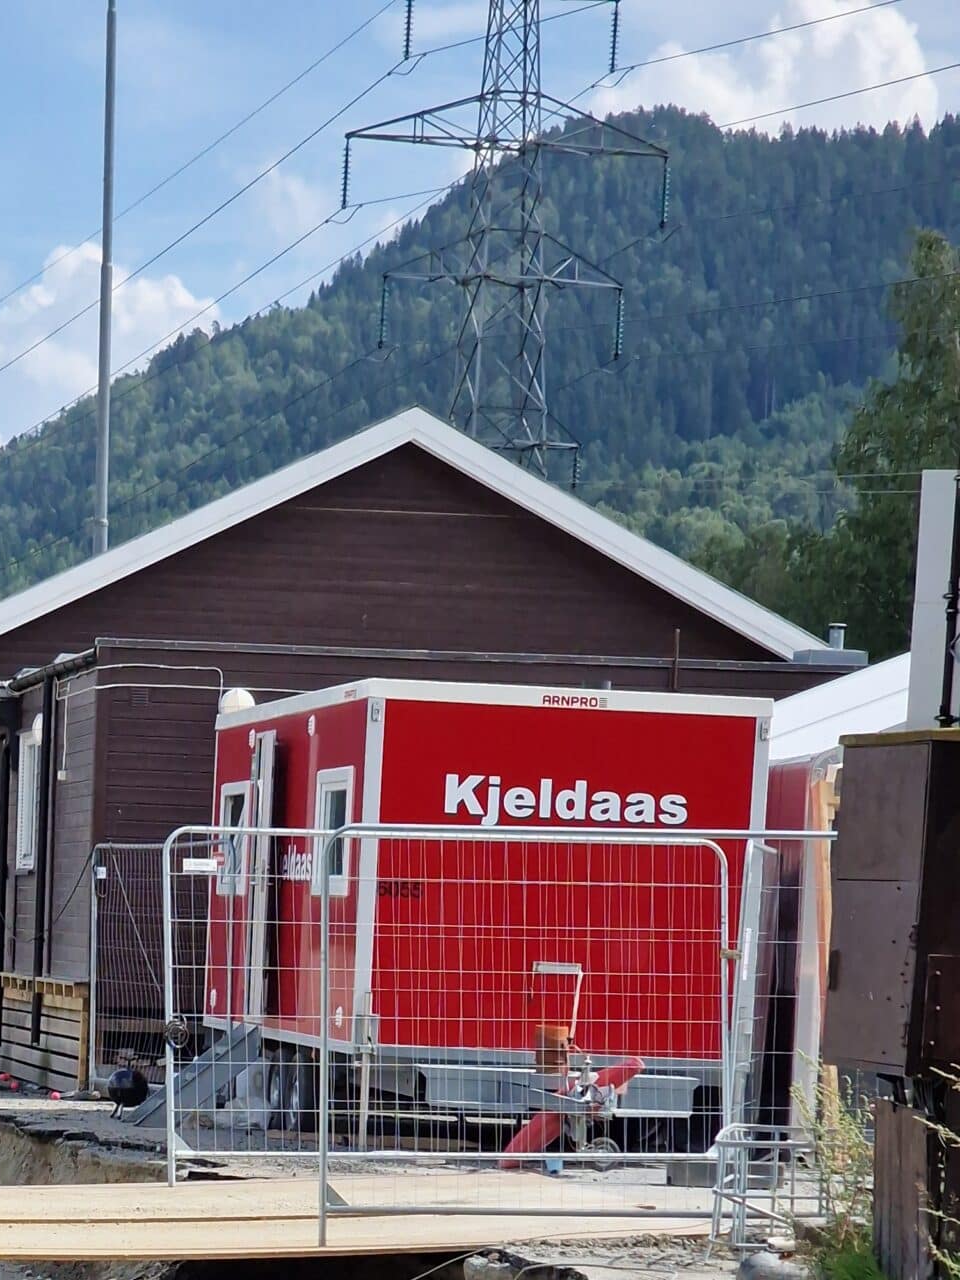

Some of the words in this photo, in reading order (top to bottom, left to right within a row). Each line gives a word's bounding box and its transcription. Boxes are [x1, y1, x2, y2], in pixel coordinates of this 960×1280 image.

[542, 694, 598, 708] ARNPRO
[444, 773, 688, 826] Kjeldaas
[279, 844, 312, 881] eldaas
